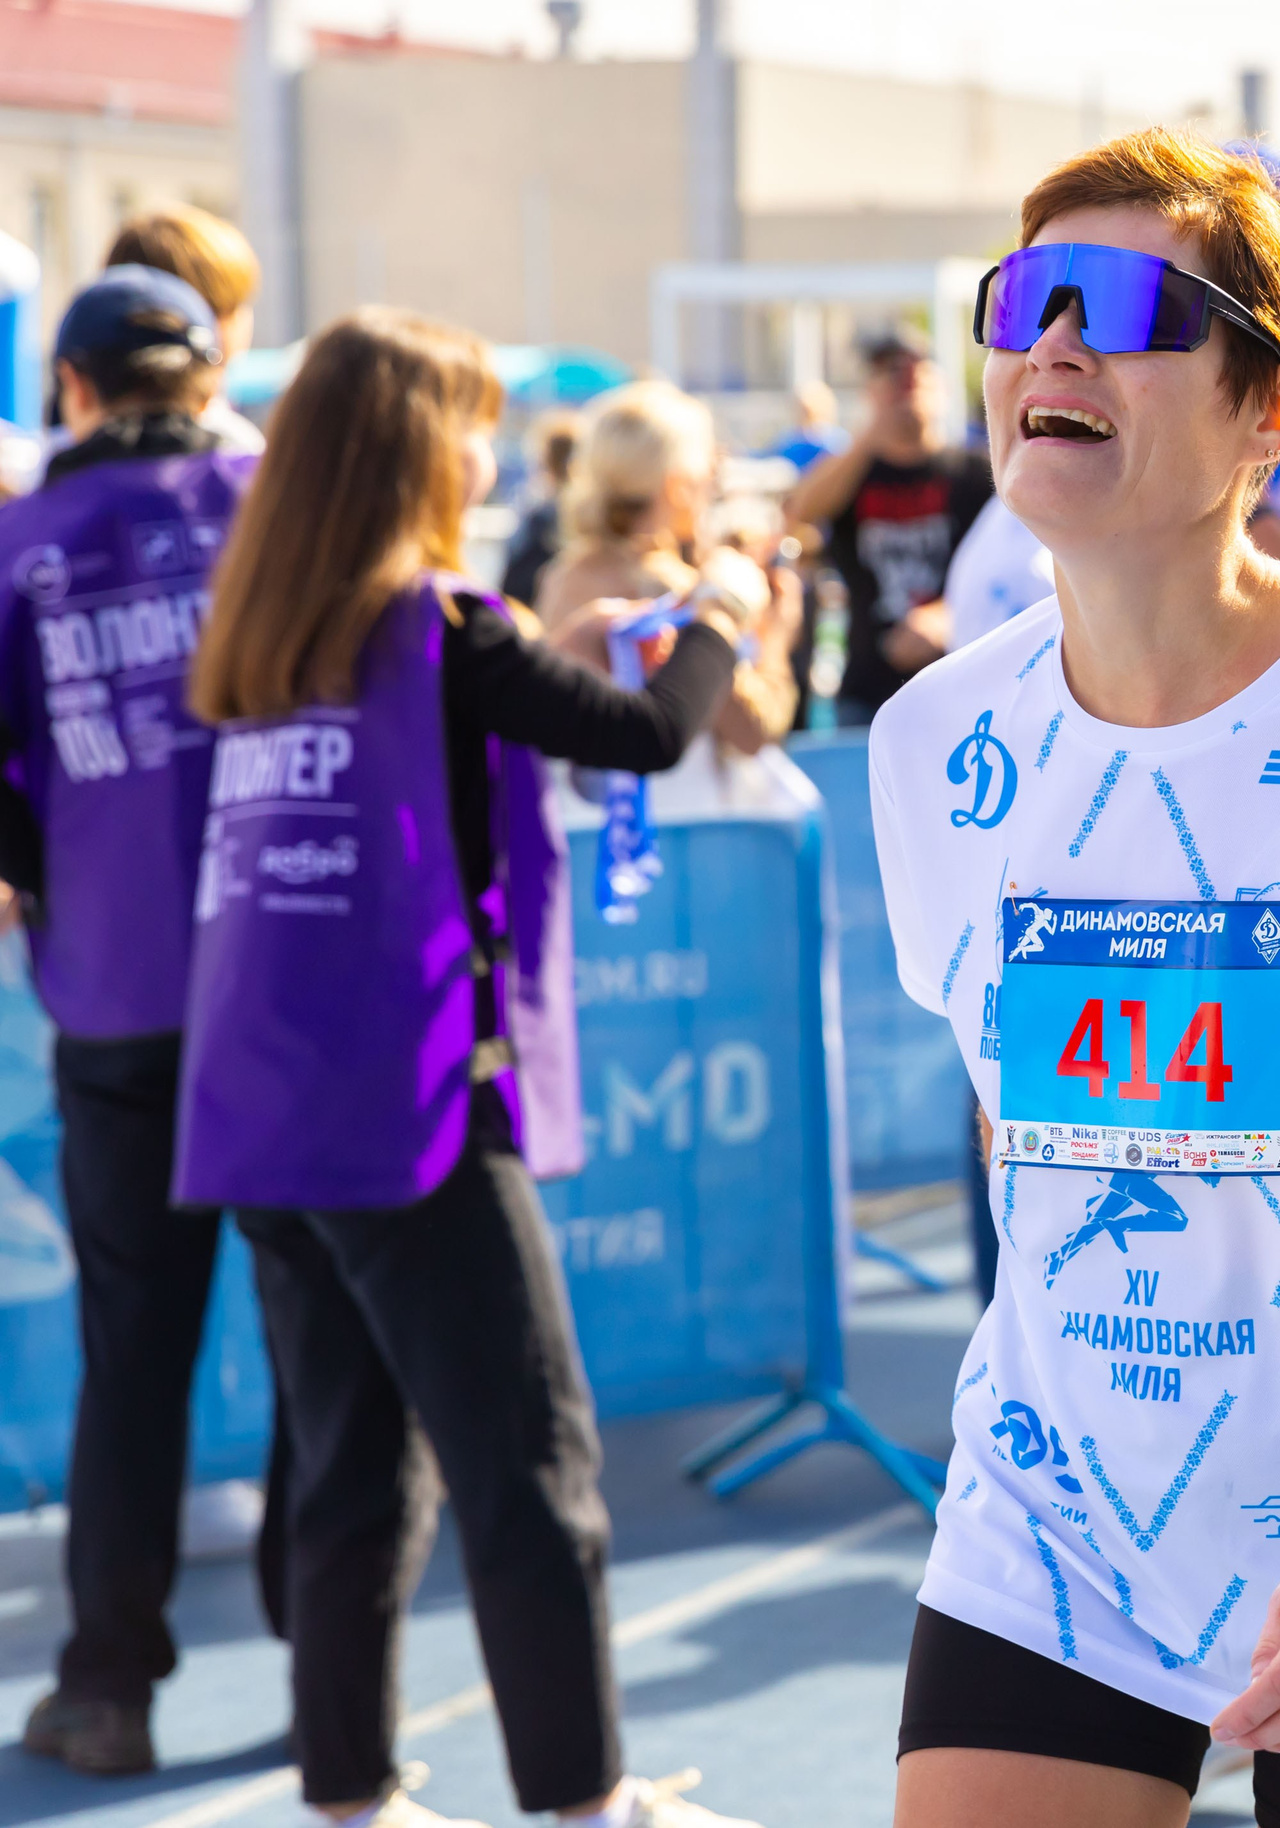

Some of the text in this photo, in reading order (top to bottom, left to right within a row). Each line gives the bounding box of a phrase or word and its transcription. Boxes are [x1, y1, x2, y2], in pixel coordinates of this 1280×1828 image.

[1060, 910, 1225, 933] ДИНАМОВСКАЯ
[1109, 938, 1167, 959] МИЛЯ
[1057, 998, 1233, 1102] 414
[1072, 1127, 1098, 1139] Nika
[1138, 1132, 1161, 1142] UDS
[1146, 1157, 1180, 1168] Effort
